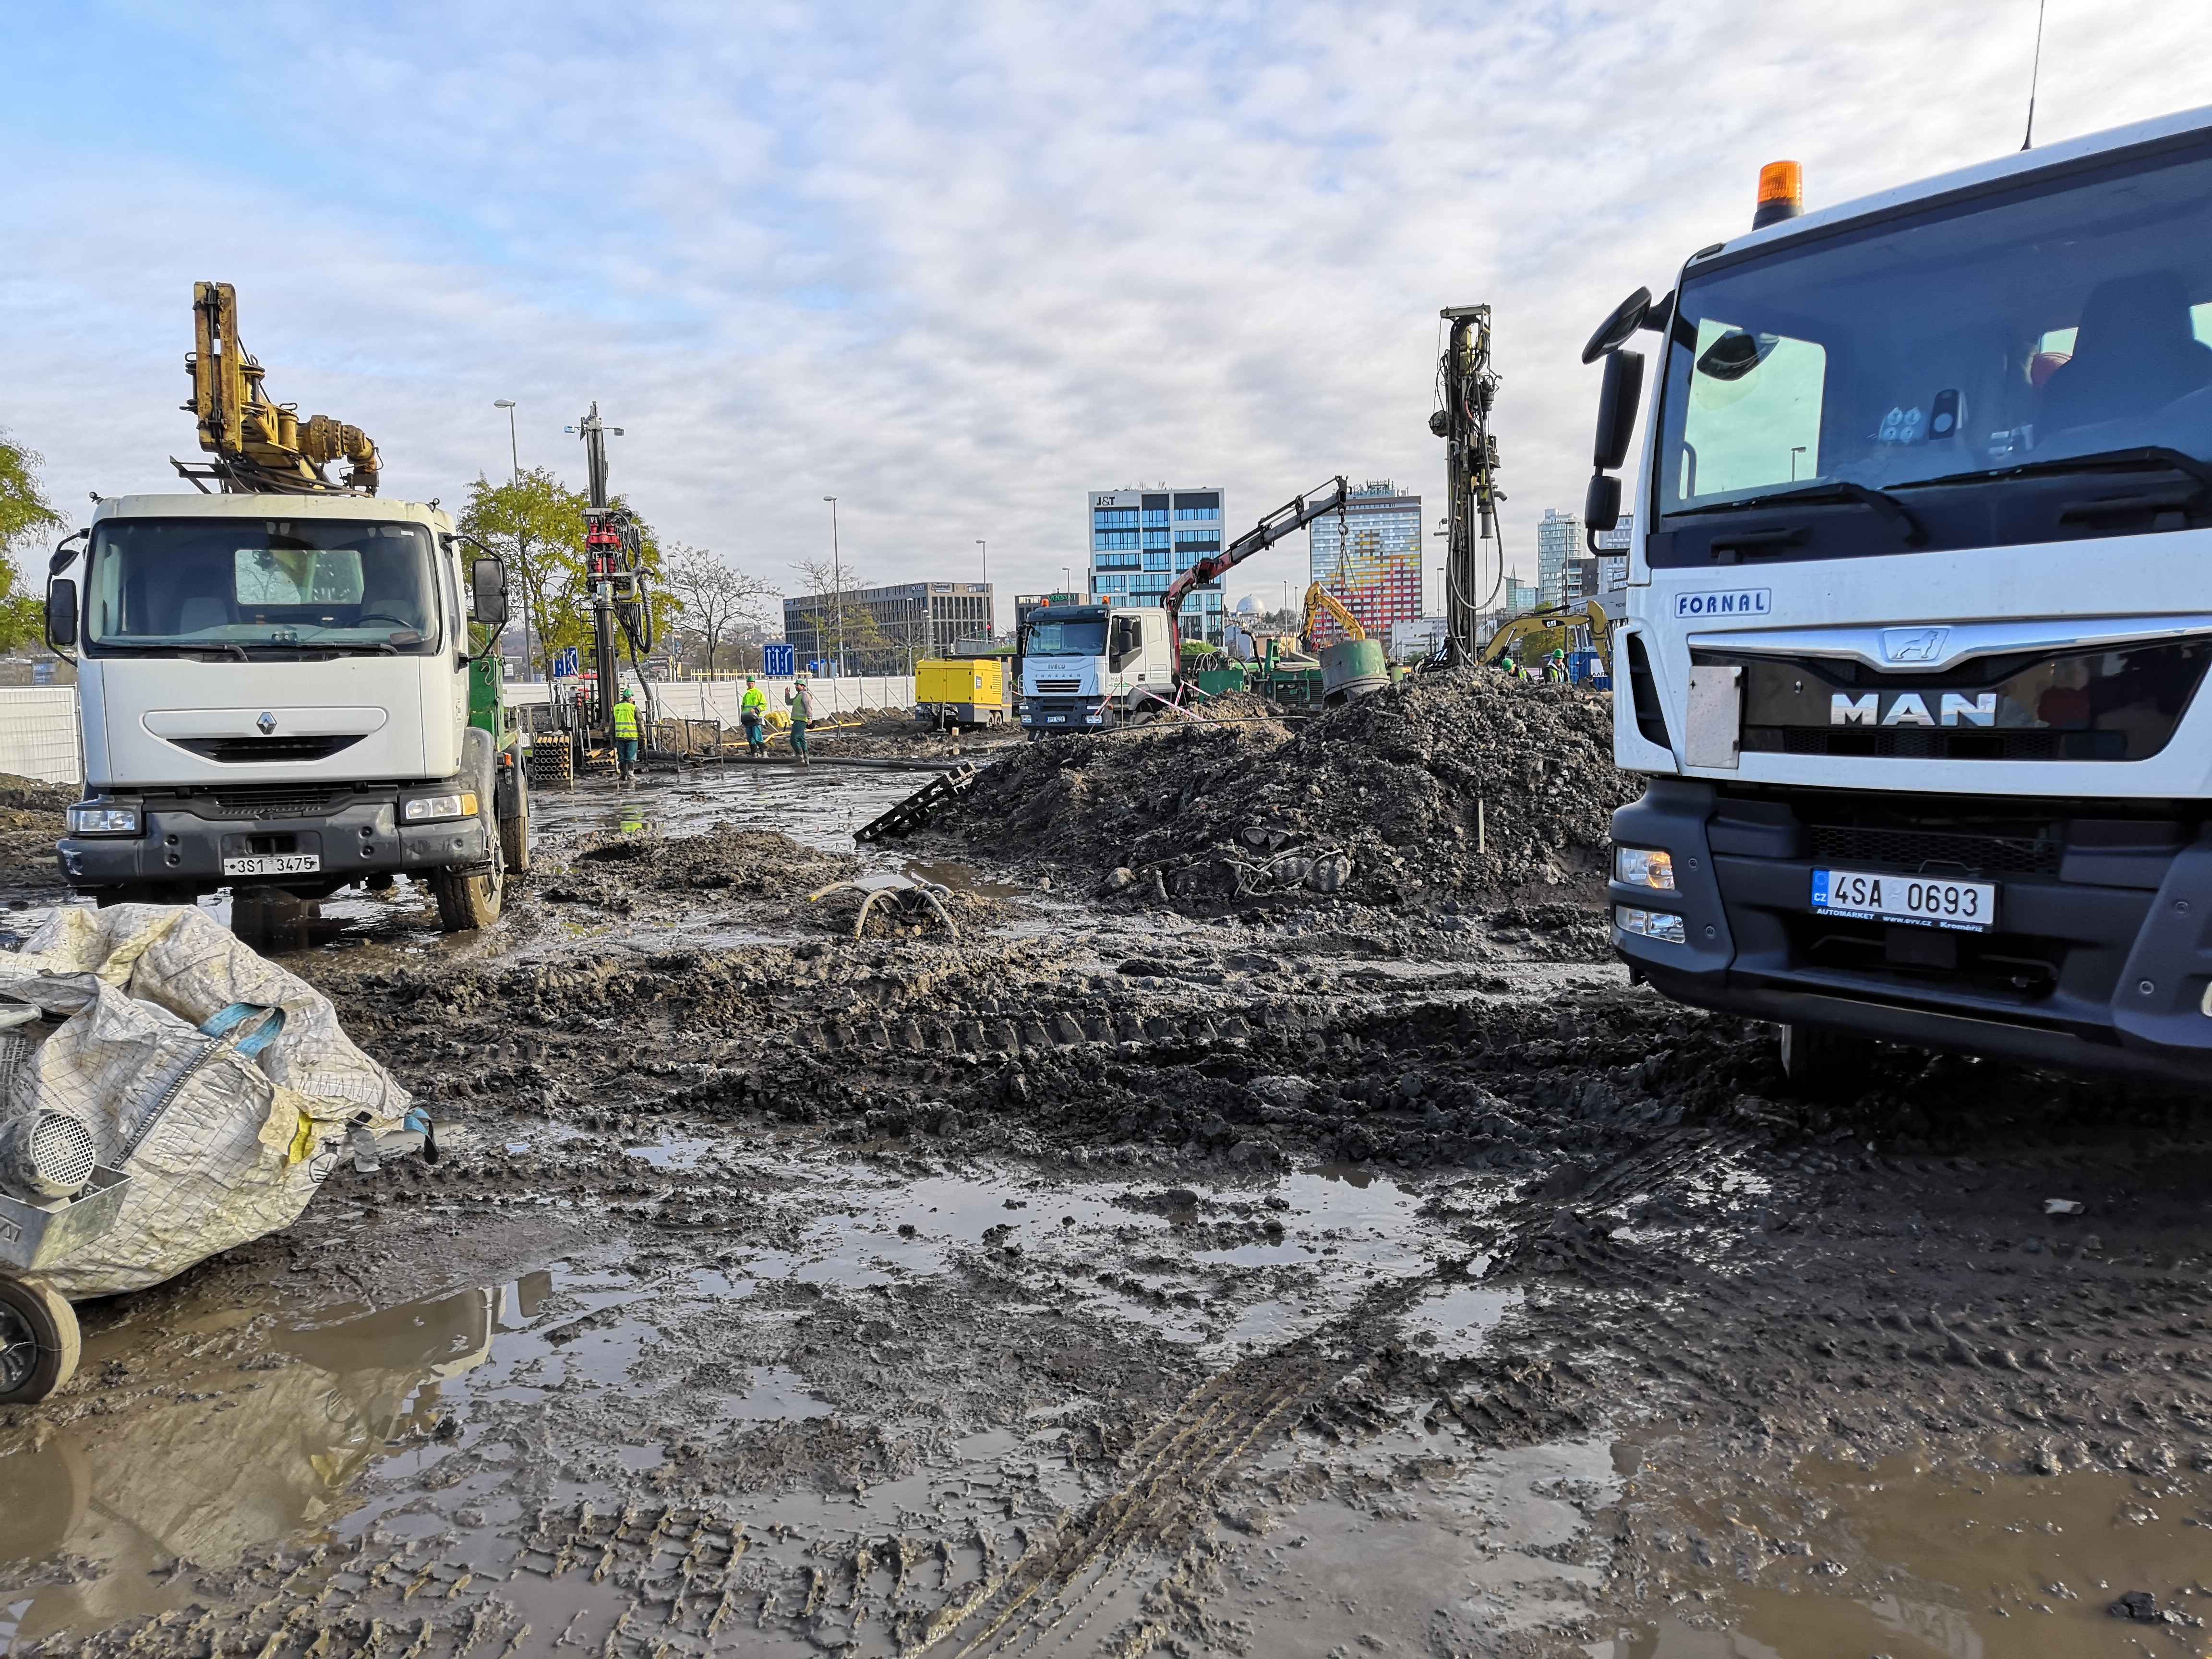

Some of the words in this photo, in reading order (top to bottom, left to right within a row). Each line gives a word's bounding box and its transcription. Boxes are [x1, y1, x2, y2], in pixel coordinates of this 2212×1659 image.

[1096, 496, 1115, 505] J&T
[1680, 592, 1764, 614] FORNAL
[1830, 693, 1997, 726] MAN
[238, 859, 264, 873] 3S1
[276, 857, 313, 871] 3475
[1813, 893, 1827, 902] CZ
[1834, 877, 1882, 908] 4SA
[1907, 883, 1978, 916] 0693
[1816, 908, 1875, 920] AUTOMARKET
